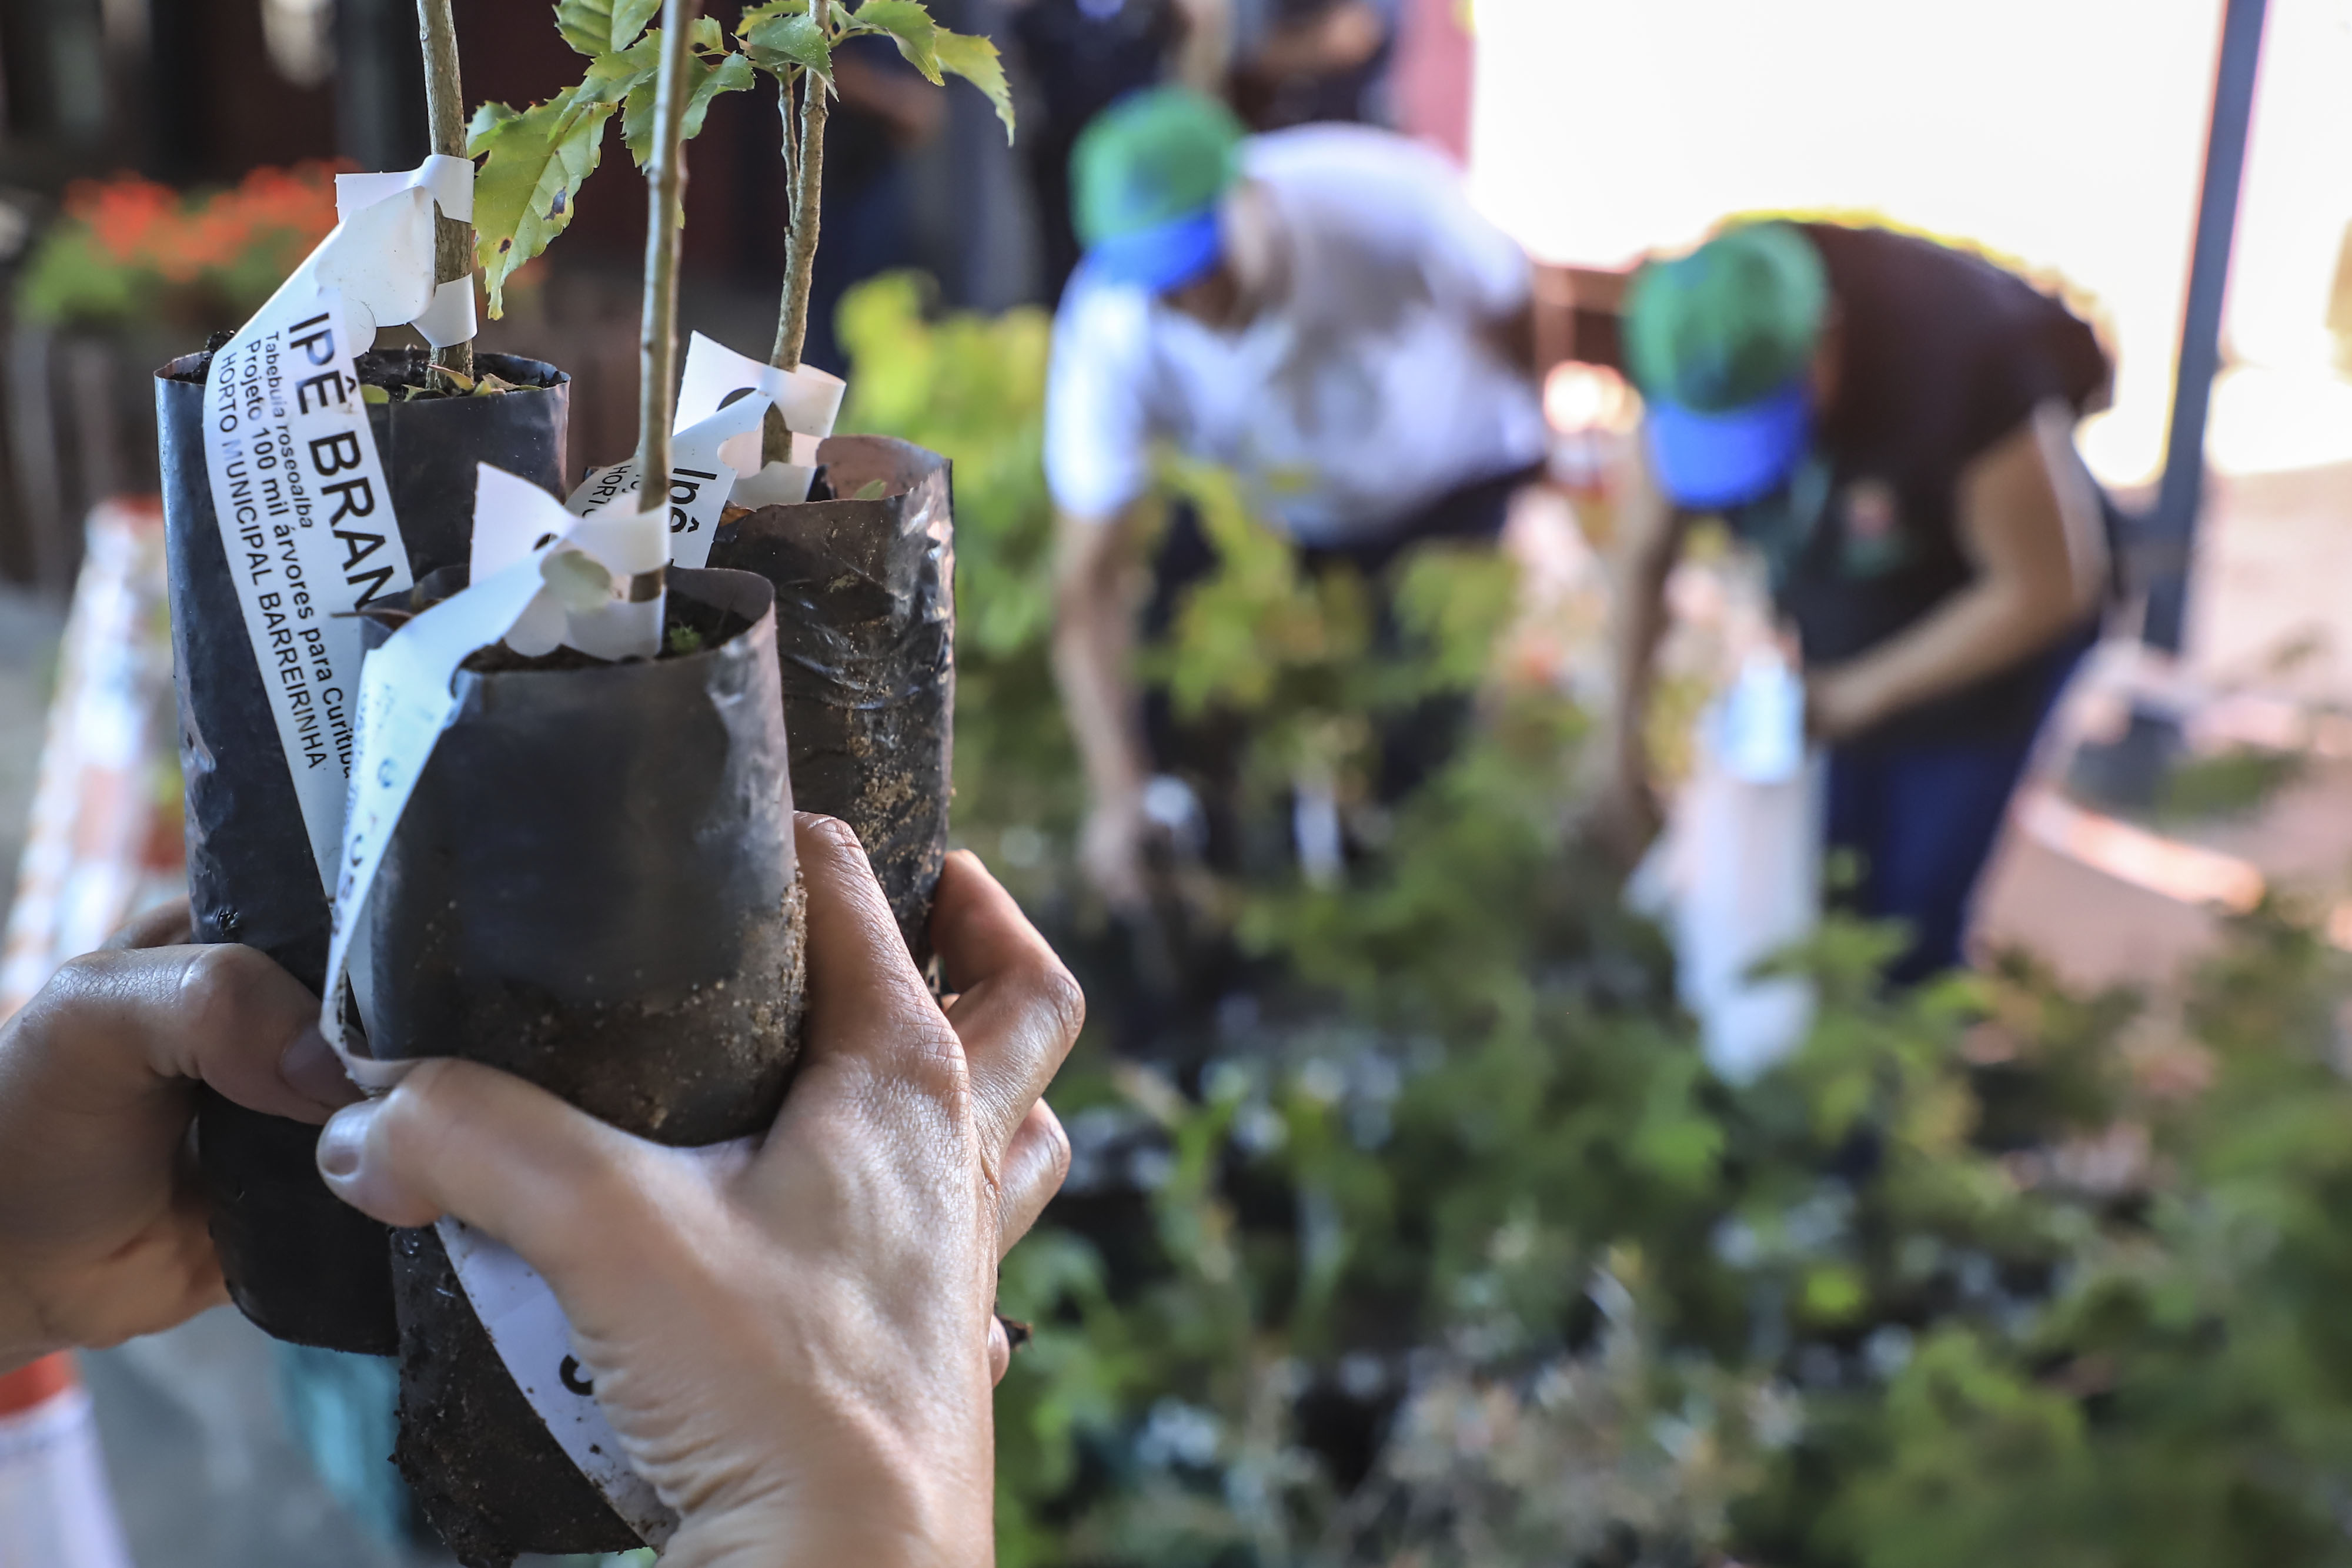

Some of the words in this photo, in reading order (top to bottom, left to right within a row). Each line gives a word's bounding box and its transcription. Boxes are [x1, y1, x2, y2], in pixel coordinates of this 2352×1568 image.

[218, 352, 238, 433] HORTO
[240, 339, 264, 421] Projeto
[266, 332, 287, 418] Tabebuia
[289, 312, 357, 415] IPÊ
[252, 427, 277, 470] 100
[275, 424, 313, 528] roseoalba
[221, 438, 272, 586] MUNICIPAL
[262, 478, 289, 516] mil
[273, 523, 315, 620] árvores
[259, 591, 328, 769] BARREIRINHA
[298, 627, 333, 682] para
